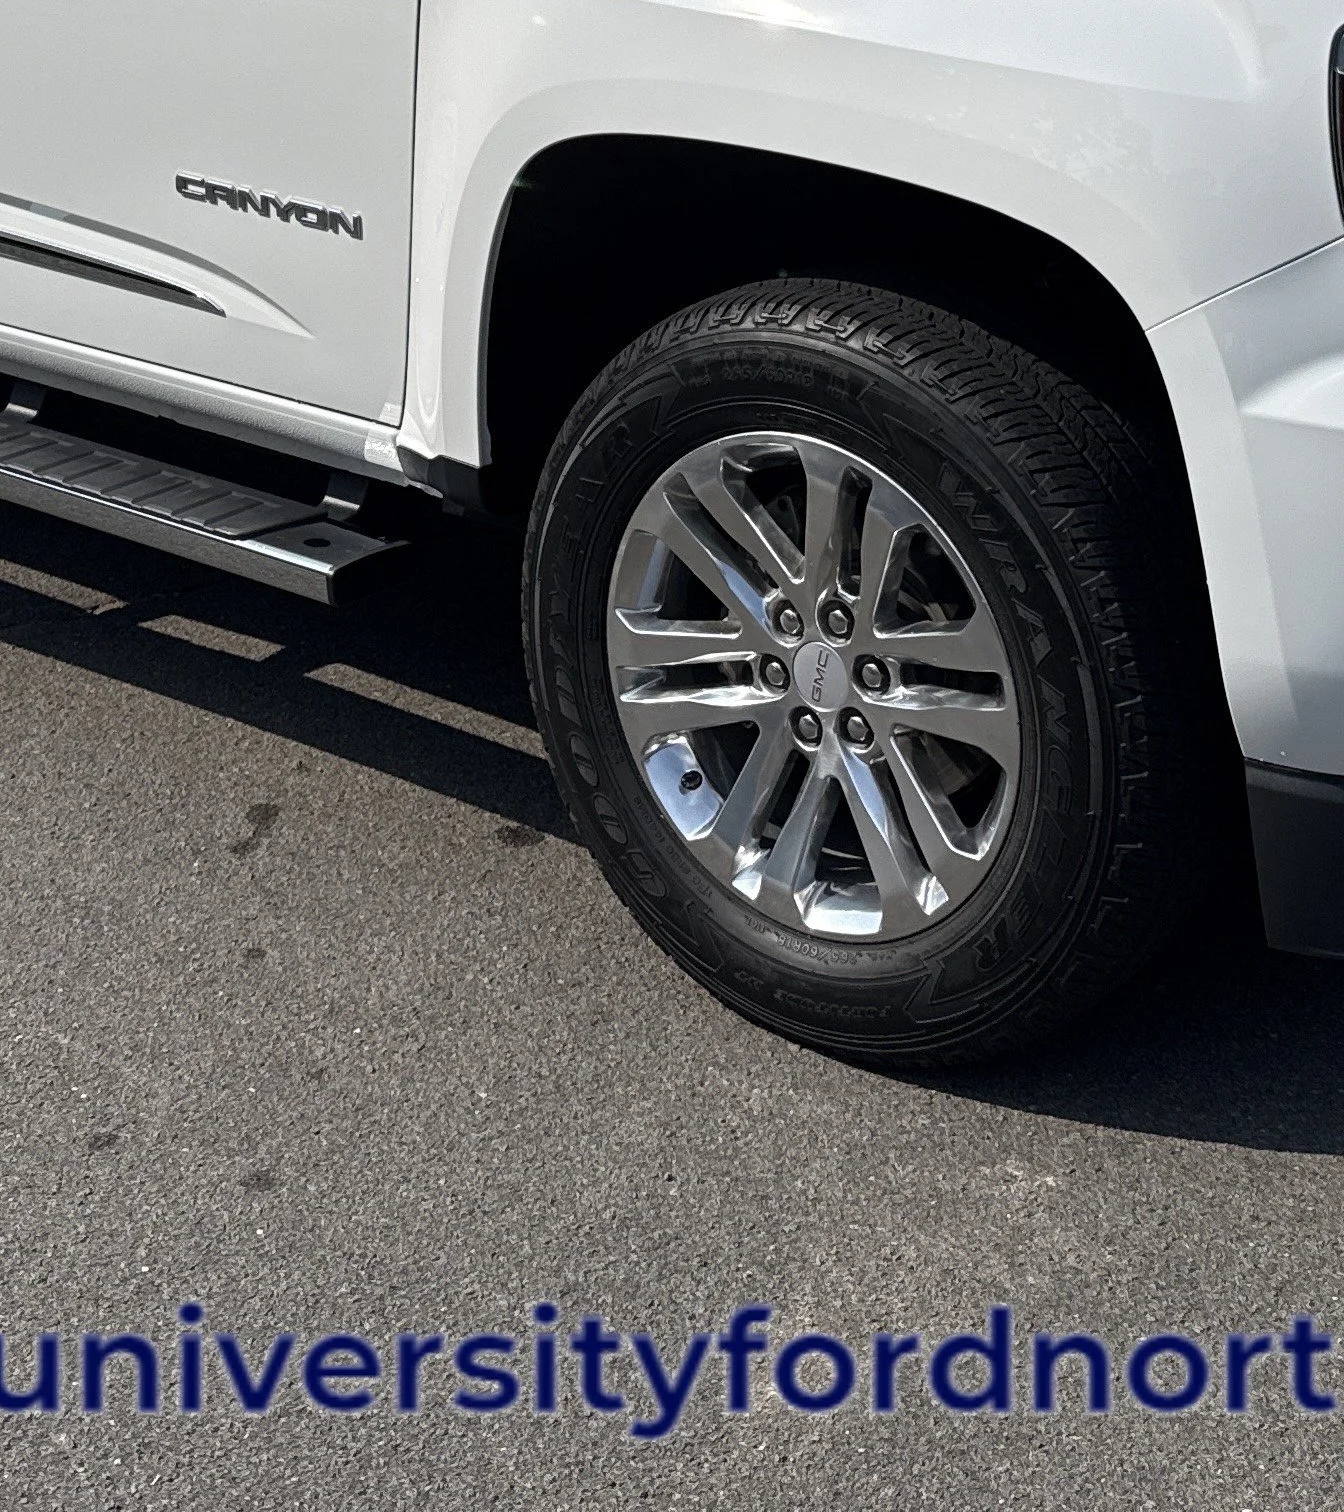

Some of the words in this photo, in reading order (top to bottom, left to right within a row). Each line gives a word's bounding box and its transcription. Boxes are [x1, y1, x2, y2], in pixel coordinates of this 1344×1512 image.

[175, 171, 363, 240] CANYON
[811, 649, 830, 703] GMC
[937, 461, 1075, 976] WRANGLER
